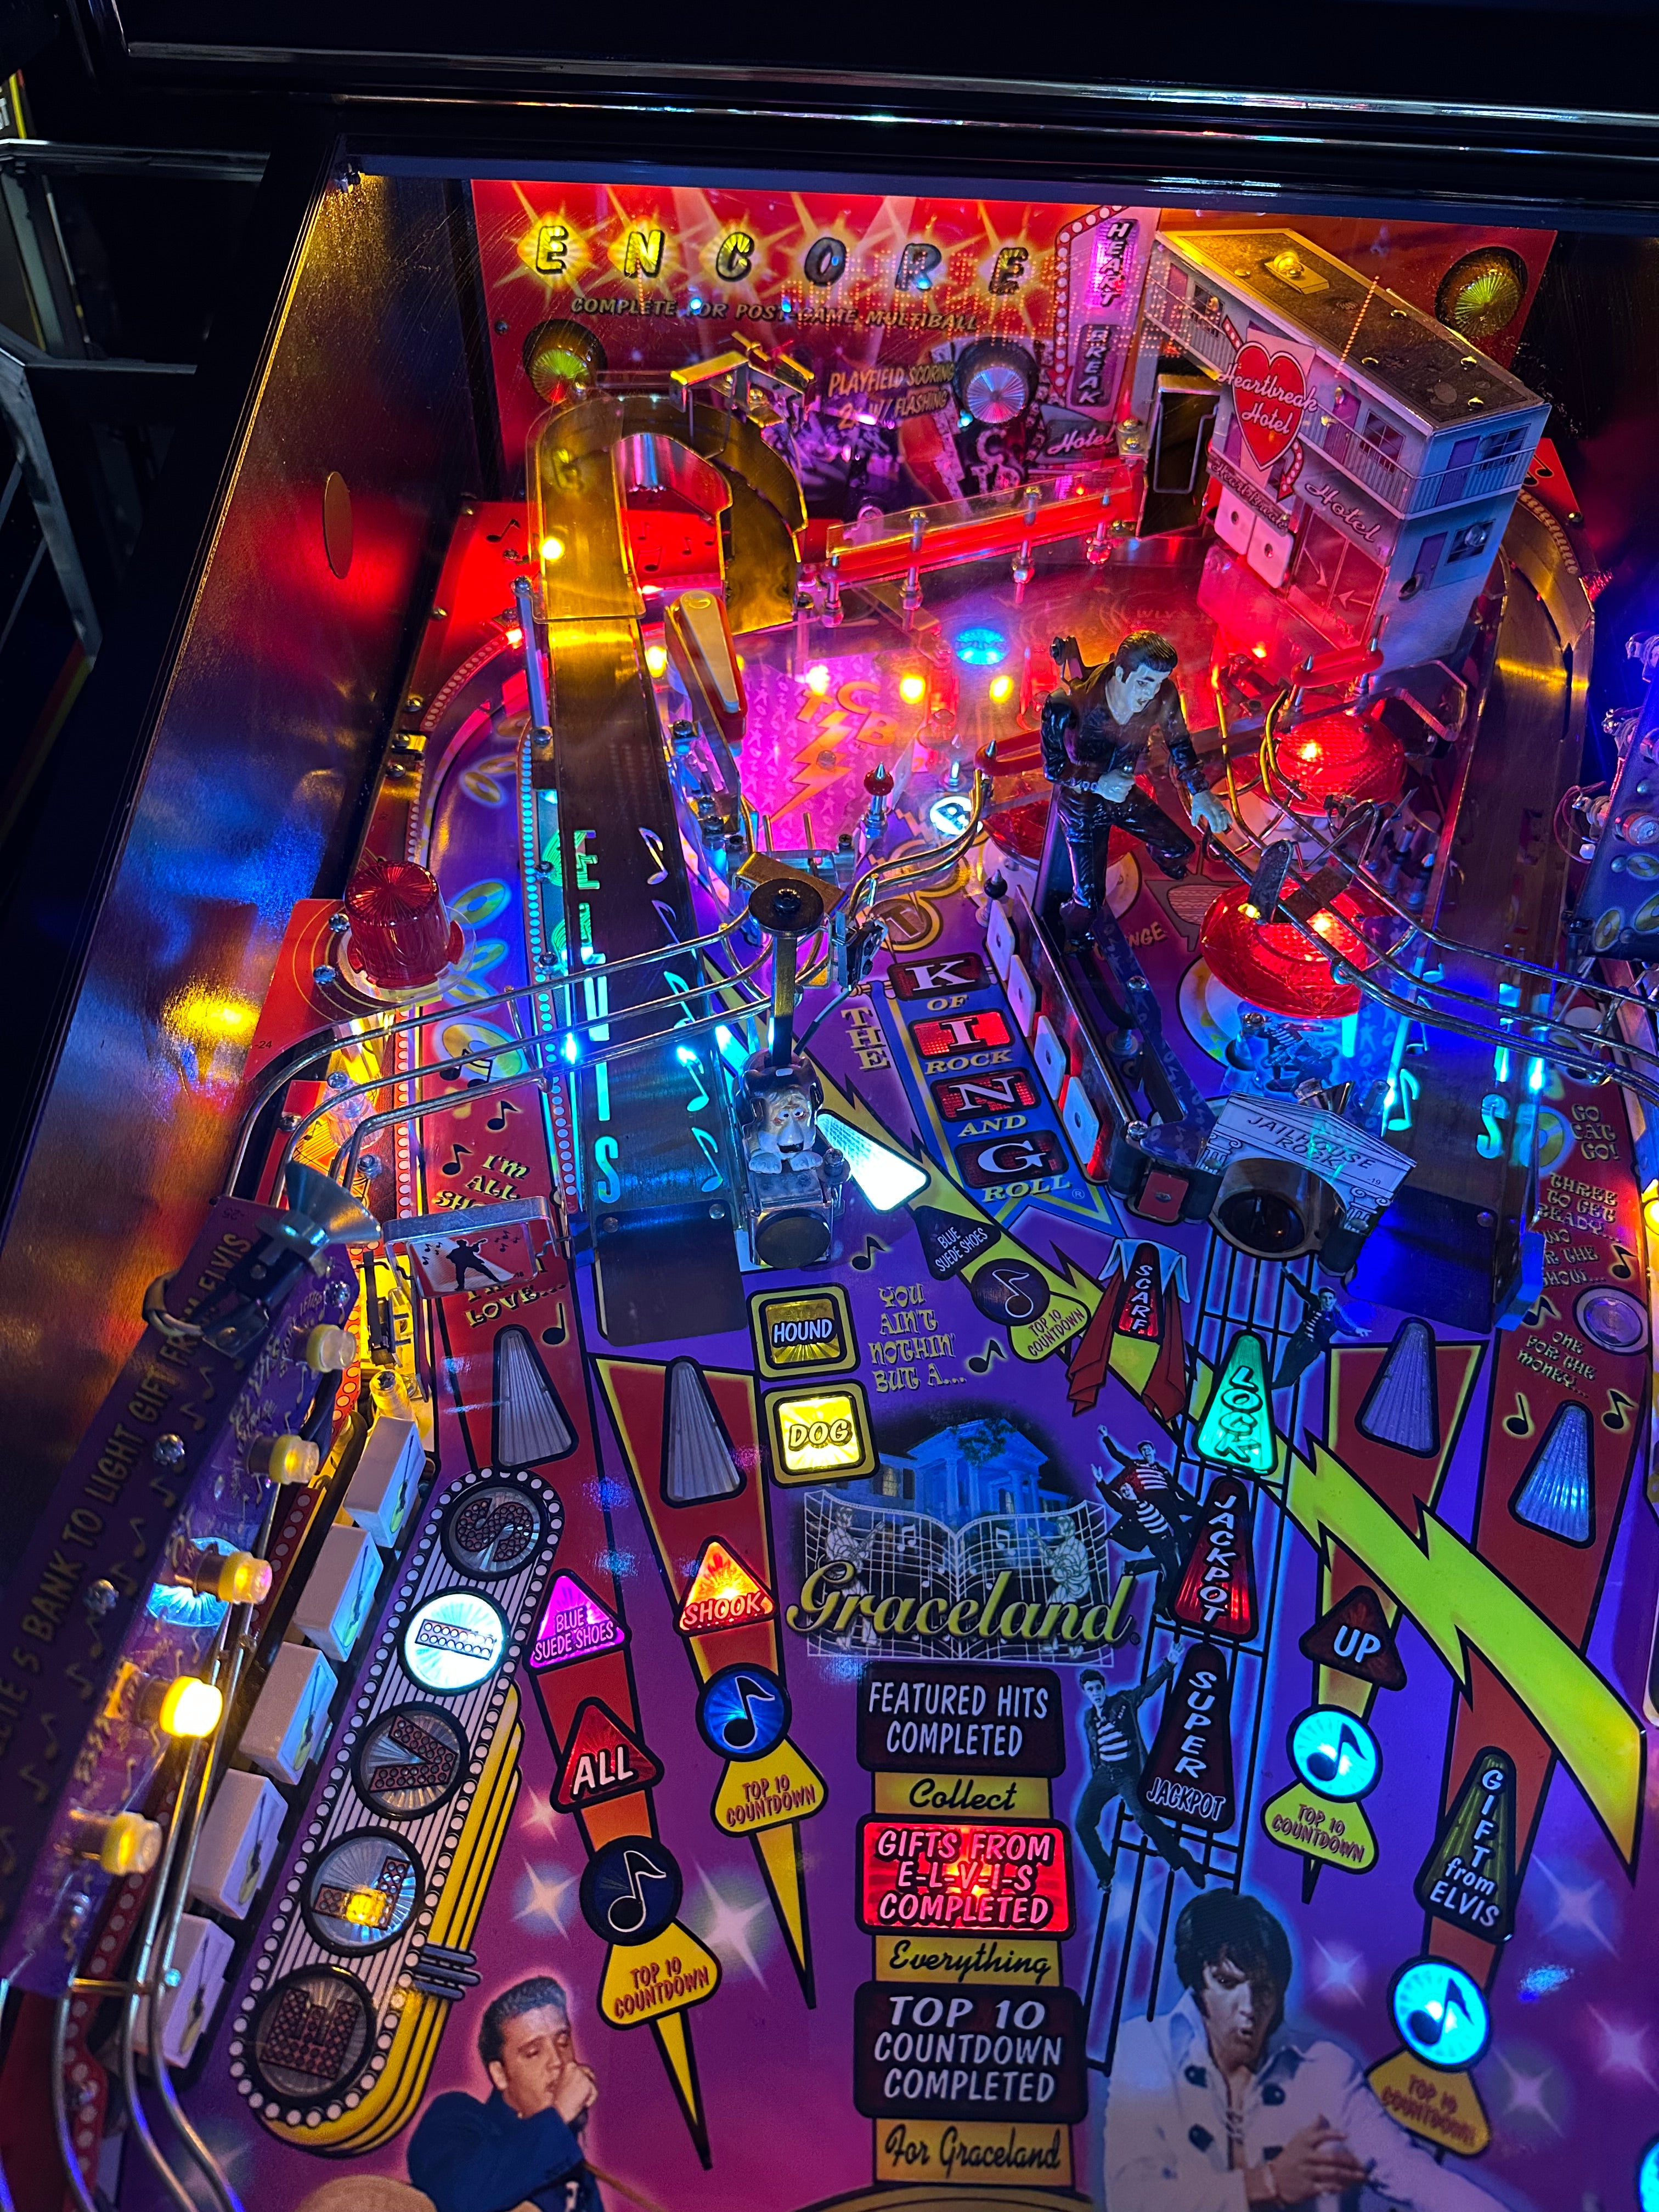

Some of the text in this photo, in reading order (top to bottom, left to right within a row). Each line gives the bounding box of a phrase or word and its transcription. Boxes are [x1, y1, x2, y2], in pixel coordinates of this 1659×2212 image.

[535, 224, 1029, 295] ENCORE
[1098, 221, 1131, 308] HEART
[571, 296, 678, 317] COMPLETE
[735, 302, 857, 326] POST-GAME
[865, 309, 980, 331] MULTIBALL
[828, 362, 955, 398] PLAYFIELD SCORING
[1078, 329, 1112, 405] BREAK
[894, 390, 949, 417] FLASHING
[1217, 363, 1319, 413] Heartbreak
[1242, 402, 1294, 435] Hotel
[1046, 421, 1116, 455] Hotel
[1304, 483, 1383, 543] Hotel
[926, 994, 970, 1012] OF
[254, 1040, 272, 1049] -24
[842, 1007, 891, 1073] THE
[923, 1049, 1014, 1076] ROCK
[957, 1114, 1028, 1138] AND
[1571, 1103, 1601, 1123] GO
[1246, 1116, 1377, 1170] JAILHOUSE
[1570, 1123, 1617, 1142] CAT
[1274, 1136, 1344, 1167] ROCK
[465, 1175, 521, 1201] ALL
[982, 1175, 1072, 1203] ROLL
[1367, 1177, 1381, 1186] -19
[1549, 1171, 1618, 1207] THREE
[1547, 1188, 1616, 1223] TO GET
[935, 1227, 988, 1272] SUEDE SHOES
[937, 1226, 962, 1249] BLUE
[1543, 1228, 1571, 1245] WO
[1564, 1245, 1600, 1263] THE
[878, 1282, 926, 1308] YOU
[1130, 1263, 1155, 1334] SCARF
[772, 1318, 834, 1344] HOUND
[878, 1308, 939, 1336] AIN'T
[1026, 1308, 1085, 1357] COUNTDOWN
[1028, 1309, 1062, 1338] TOP 10
[868, 1333, 957, 1365] NOTHIN'
[1526, 1334, 1598, 1381] FOR THE
[1553, 1330, 1583, 1355] ONE
[872, 1368, 922, 1393] BUT
[1214, 1364, 1263, 1464] LOCK
[788, 1418, 854, 1452] DOG
[21, 1549, 84, 1644] BANK
[61, 1506, 104, 1548] TO
[83, 1422, 146, 1506] LIGHT
[127, 1361, 182, 1425] GIFT
[1198, 1493, 1239, 1623] JACKPOT
[685, 1592, 763, 1627] SHOOK
[786, 1561, 1133, 1644] Graceland
[555, 1607, 586, 1634] BLUE
[534, 1621, 615, 1662] SUEDE SHOES
[1333, 1624, 1383, 1664] UP
[868, 1681, 1049, 1719] FEATURED HITS
[886, 1720, 1024, 1757] COMPLETED
[1174, 1670, 1218, 1781] SUPER
[572, 1746, 635, 1797] ALL
[742, 1773, 791, 1801] TOP 10
[725, 1784, 817, 1828] COUNTDOWN
[909, 1778, 1018, 1811] Collect
[1146, 1775, 1228, 1822] JACKPOT
[1297, 1803, 1346, 1836] TOP 10
[1471, 1769, 1504, 1868] GIFT
[878, 1829, 1052, 1861] GIFTS FROM
[1271, 1813, 1365, 1863] COUNTDOWN
[897, 1860, 1035, 1893] E-L-V-I-S
[1444, 1857, 1496, 1896] from
[879, 1892, 1050, 1925] COMPLETED
[1429, 1880, 1501, 1927] ELVIS
[629, 1955, 682, 1991] TOP 10
[889, 1939, 1052, 1985] Everything
[613, 1964, 710, 2019] COUNTDOWN
[889, 1995, 1046, 2030] TOP 10
[874, 2031, 1064, 2066] COUNTDOWN
[883, 2067, 1056, 2103] COMPLETED
[1408, 2073, 1437, 2101] TOP
[1380, 2084, 1479, 2147] COUNTDOWN
[884, 2123, 1062, 2178] For Graceland
